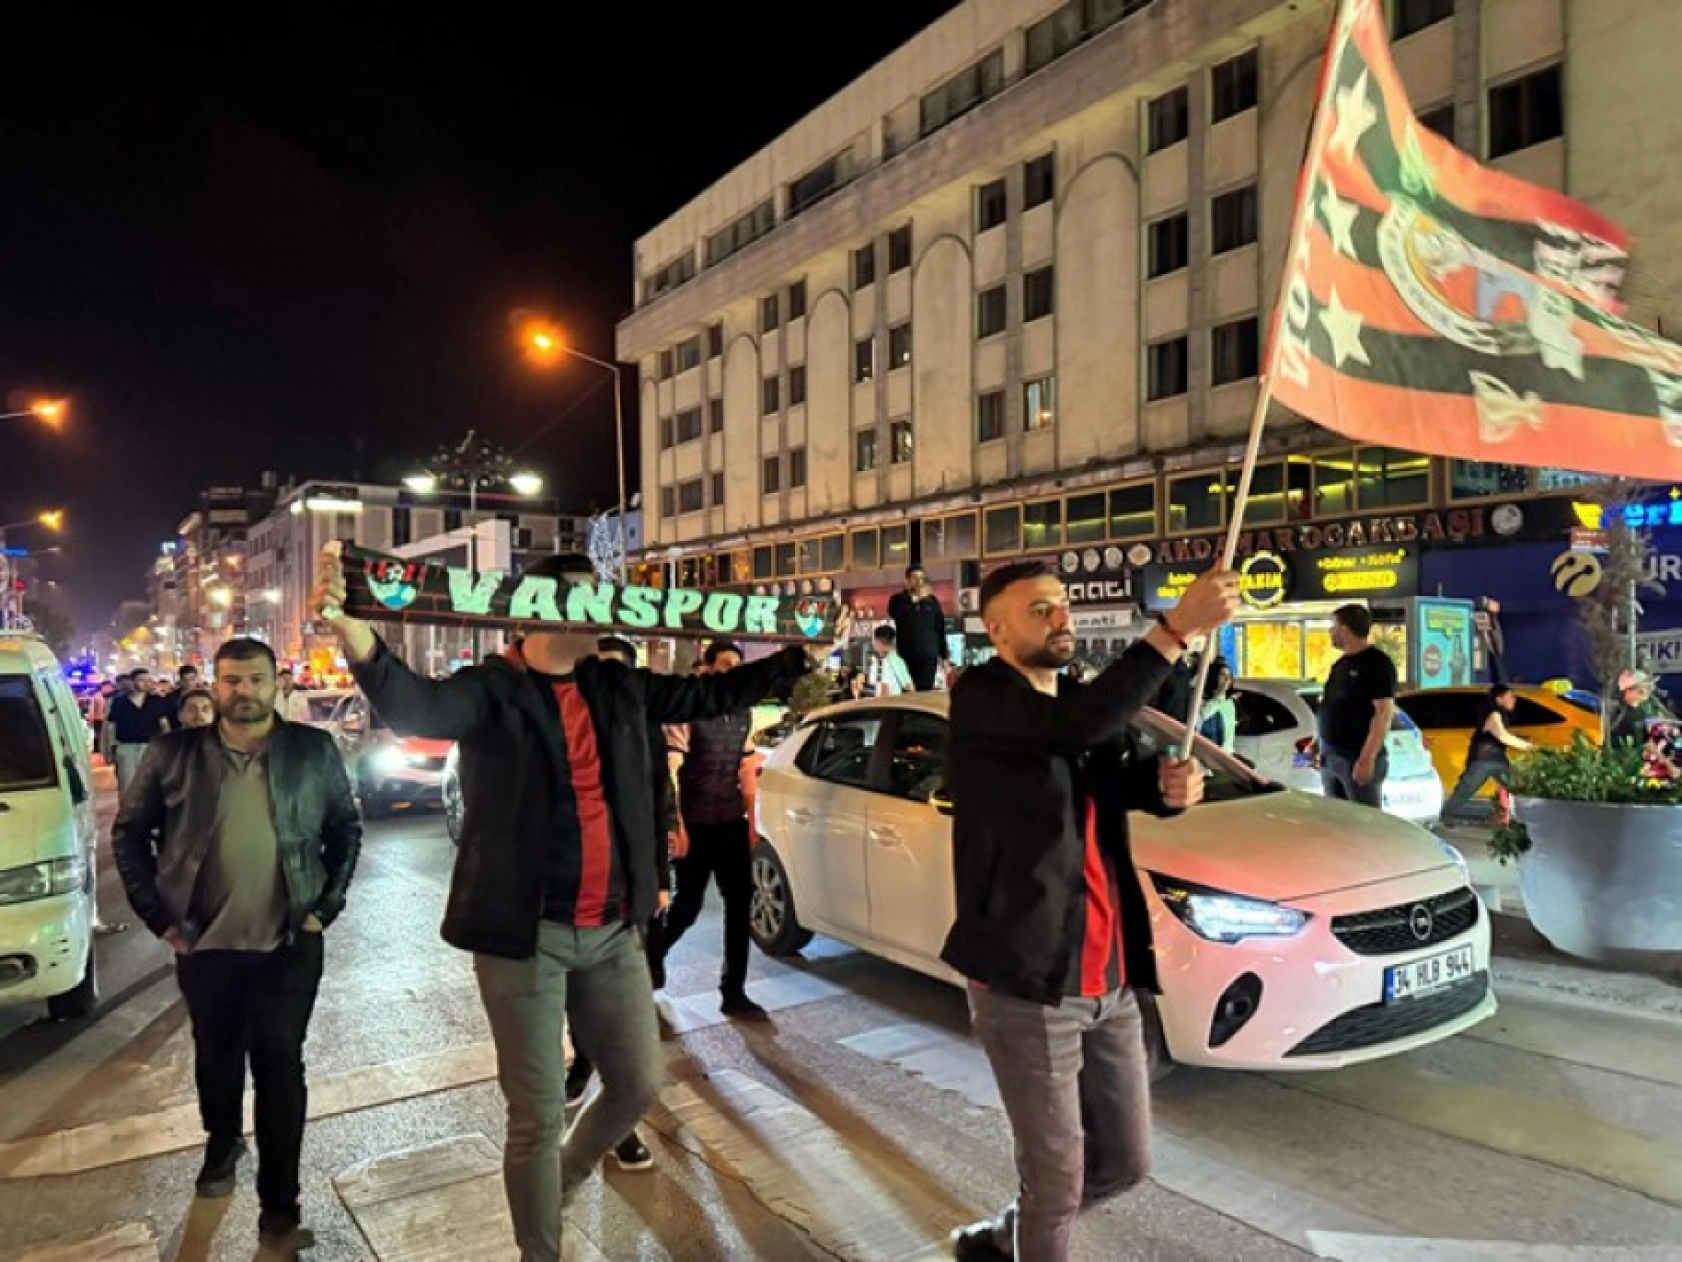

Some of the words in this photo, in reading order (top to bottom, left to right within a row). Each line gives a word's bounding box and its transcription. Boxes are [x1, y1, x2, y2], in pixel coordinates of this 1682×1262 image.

[447, 566, 780, 634] VANSPOR
[1394, 967, 1410, 994] 34
[1446, 949, 1470, 977] 944
